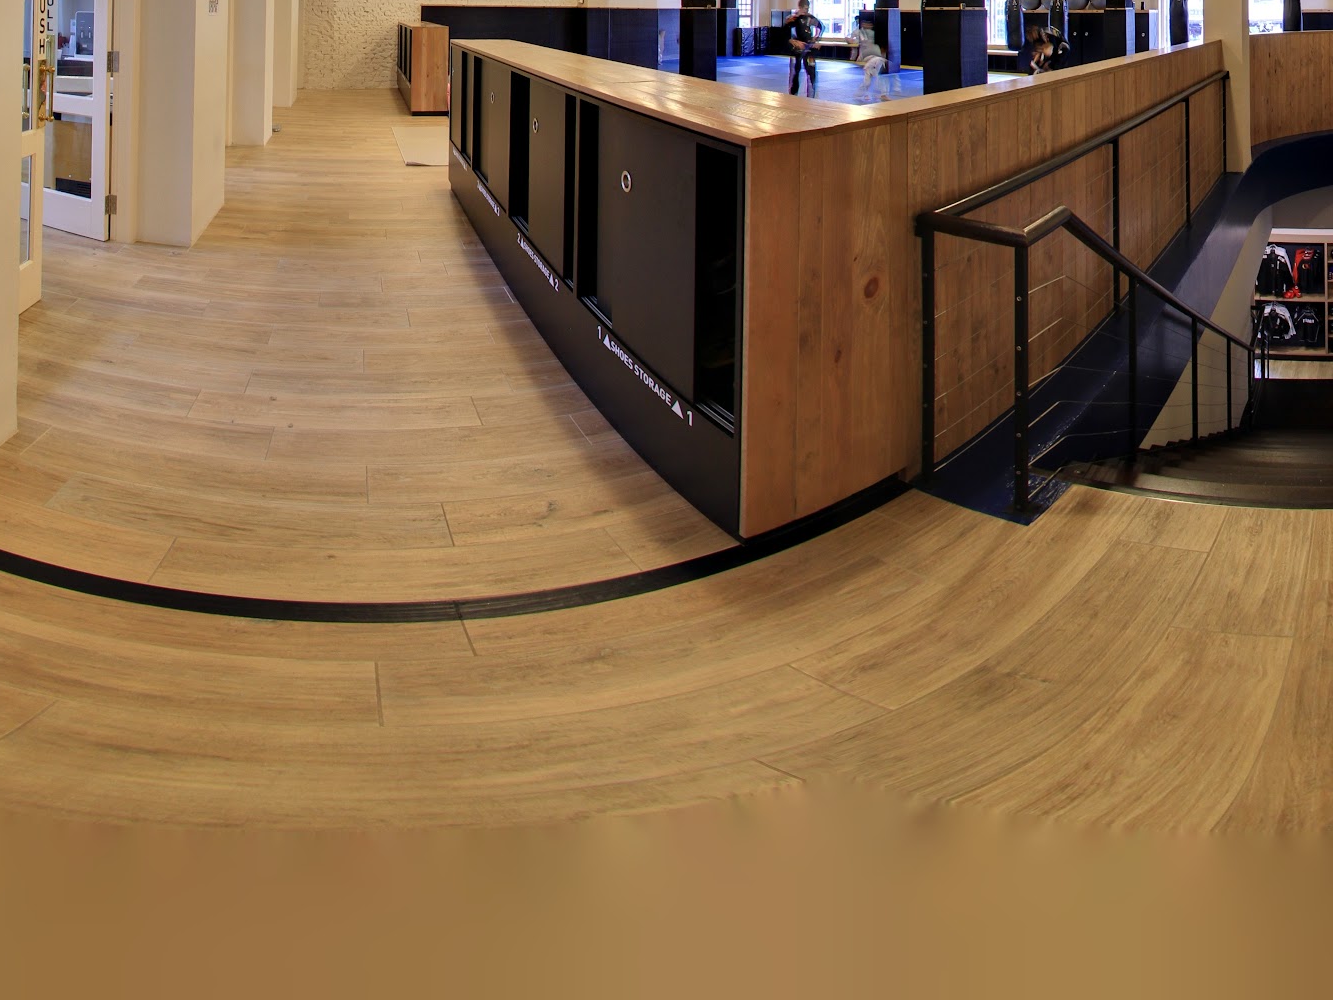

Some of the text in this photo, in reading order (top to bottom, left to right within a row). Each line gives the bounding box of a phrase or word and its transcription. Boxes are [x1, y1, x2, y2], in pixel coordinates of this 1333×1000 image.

[554, 278, 559, 292] 2
[597, 325, 693, 427] 1 SHOES STORAGE 1
